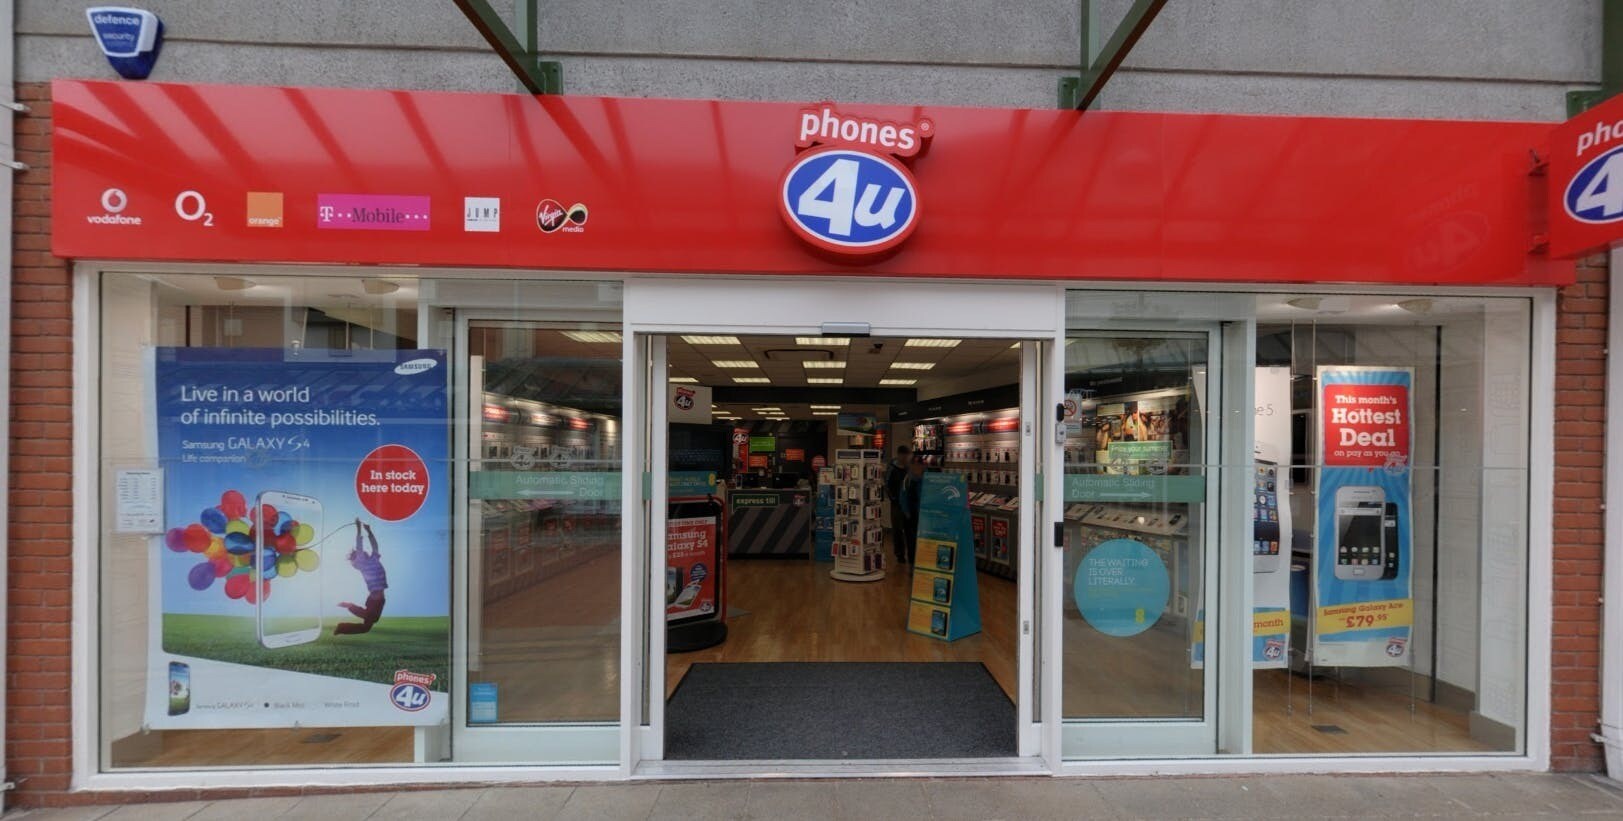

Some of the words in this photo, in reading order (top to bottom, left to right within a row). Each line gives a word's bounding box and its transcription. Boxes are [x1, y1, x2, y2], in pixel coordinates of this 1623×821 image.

[800, 108, 915, 150] phones
[798, 158, 906, 237] 4u
[87, 214, 142, 226] vodafone
[248, 217, 281, 226] orange
[538, 204, 564, 227] Virgin
[562, 225, 585, 233] media
[180, 386, 217, 403] Live
[222, 388, 240, 403] in
[243, 391, 254, 403] a
[258, 386, 310, 403] world
[1334, 394, 1357, 404] This
[1357, 396, 1398, 405] month's
[180, 408, 199, 425] of
[203, 409, 266, 425] infinite
[271, 409, 381, 429] possibilities.
[1331, 407, 1401, 425] Hottest
[1339, 427, 1396, 447] Deal
[181, 439, 225, 452] Samsung
[227, 436, 286, 450] GALAXY
[199, 454, 247, 464] companion
[1346, 450, 1361, 458] pay
[1374, 450, 1389, 458] you
[369, 469, 383, 481] In
[385, 469, 416, 481] stock
[515, 474, 568, 485] Automatic
[361, 482, 388, 493] here
[390, 482, 425, 496] today
[1072, 478, 1120, 488] Automatic
[1088, 558, 1106, 567] THE
[1107, 558, 1149, 567] WAITING
[1099, 567, 1123, 576] OVER
[1358, 603, 1386, 613] Galaxy
[397, 671, 430, 684] phones
[395, 685, 427, 708] 4u
